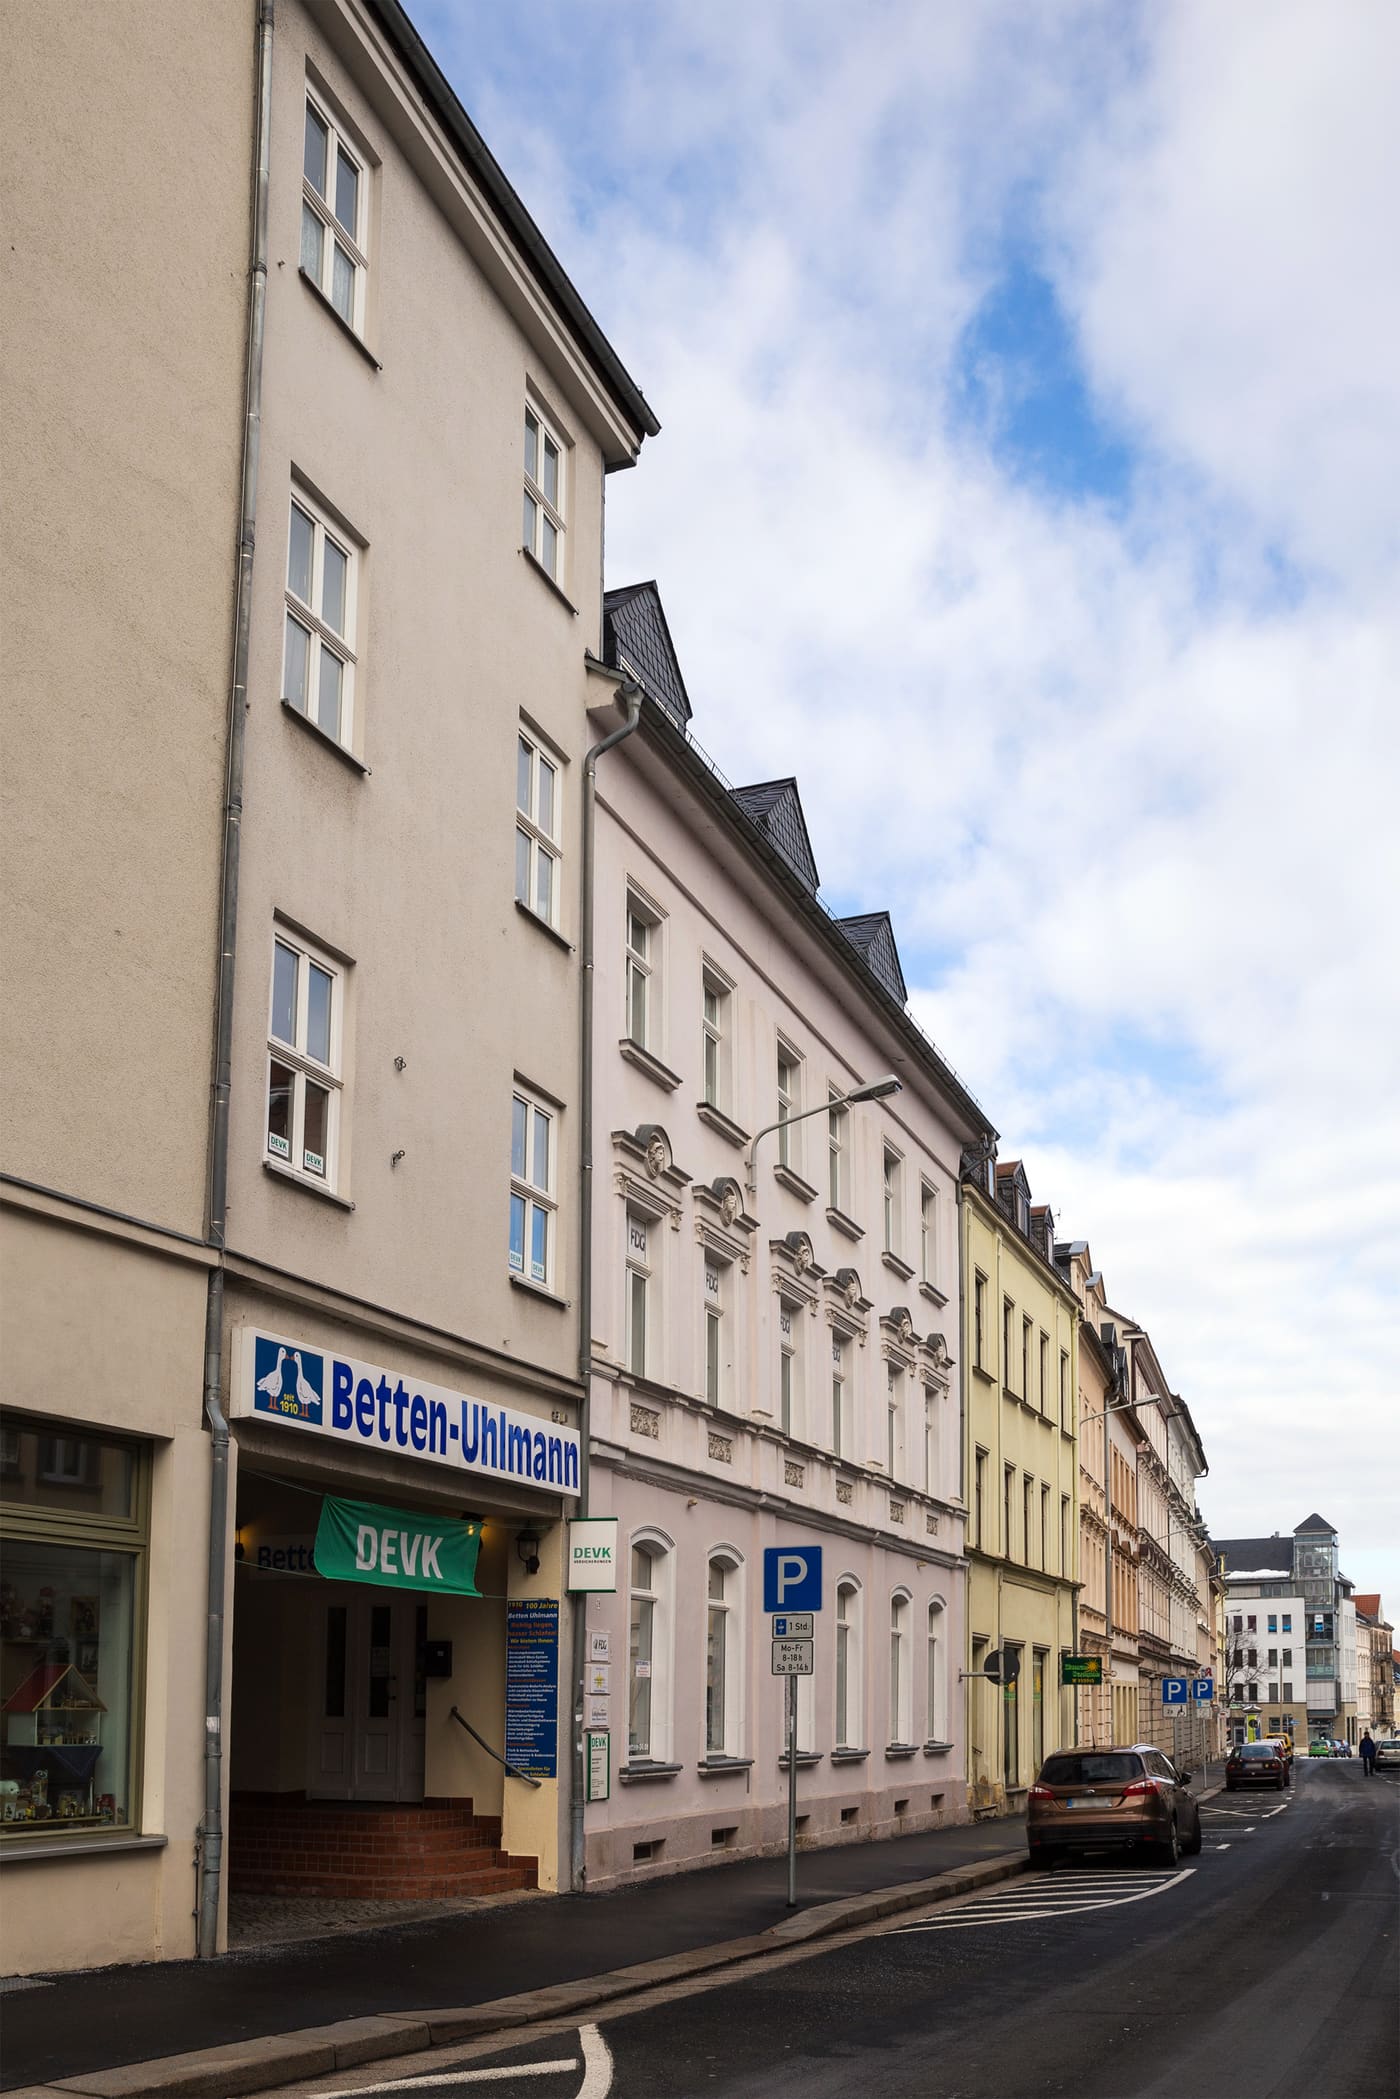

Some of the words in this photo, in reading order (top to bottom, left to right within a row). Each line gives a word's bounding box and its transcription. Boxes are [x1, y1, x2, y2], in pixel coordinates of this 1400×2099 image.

[270, 1136, 288, 1150] DEVK
[306, 1153, 322, 1167] DEVK
[631, 1229, 646, 1251] FDG
[706, 1272, 718, 1293] FDG
[283, 1393, 295, 1402] seit
[280, 1401, 298, 1415] 1910
[332, 1360, 578, 1489] Betten-Uhlmann
[355, 1525, 444, 1579] DEVK
[574, 1547, 611, 1559] DEVK
[777, 1555, 808, 1604] P
[538, 1601, 558, 1609] Jahre
[789, 1622, 793, 1631] 1
[795, 1622, 810, 1631] Std.
[781, 1644, 803, 1652] Mo-Fr
[776, 1664, 786, 1672] Sa
[1167, 1681, 1182, 1701] P
[1197, 1681, 1209, 1697] P
[591, 1737, 606, 1748] DEVK
